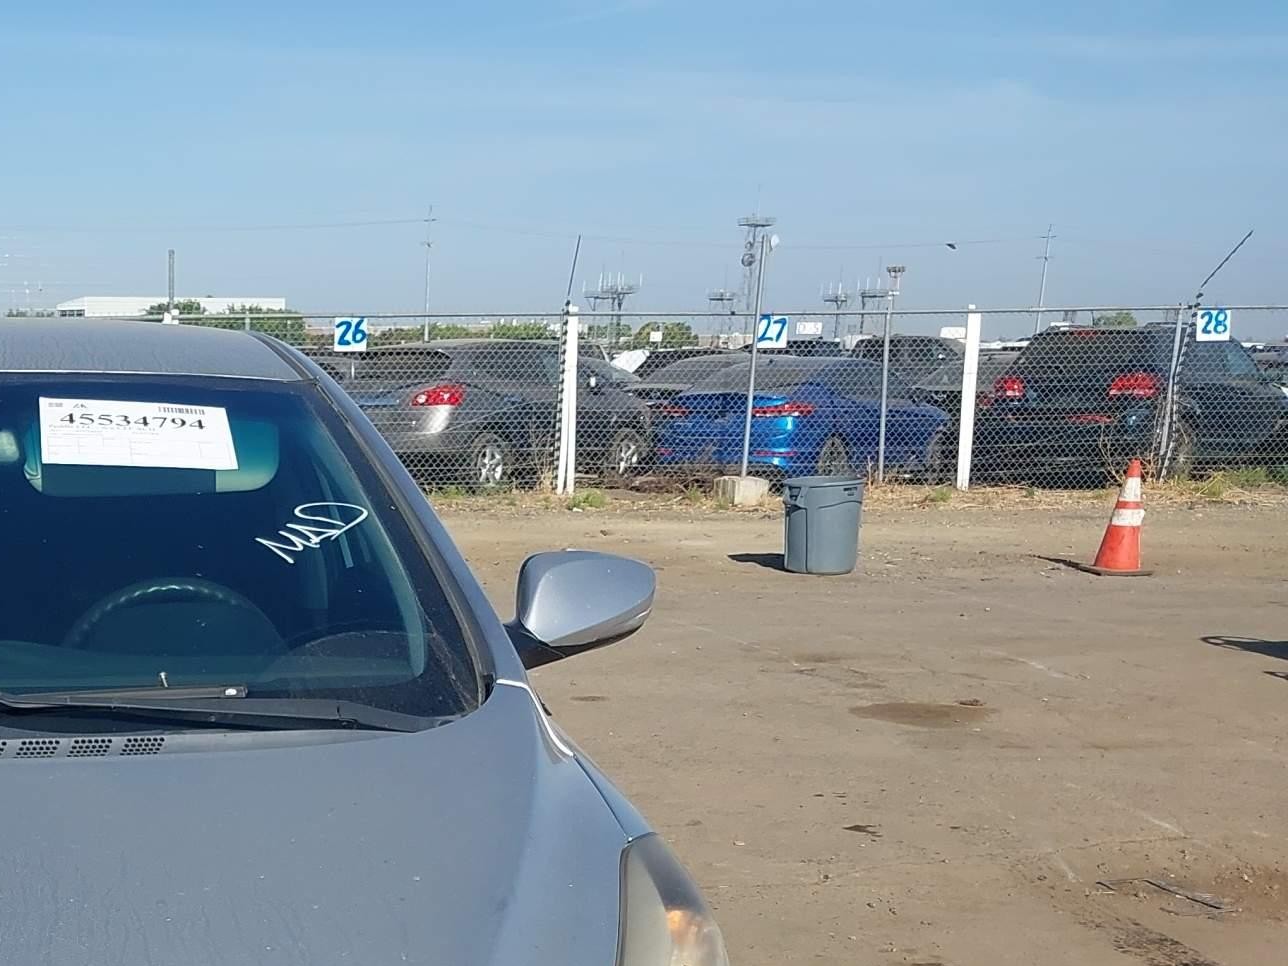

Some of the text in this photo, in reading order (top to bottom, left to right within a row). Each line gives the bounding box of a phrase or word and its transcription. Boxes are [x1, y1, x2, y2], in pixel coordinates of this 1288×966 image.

[335, 315, 367, 346] 26
[756, 314, 787, 343] 27
[1199, 308, 1228, 334] 28
[59, 412, 207, 431] 45534794
